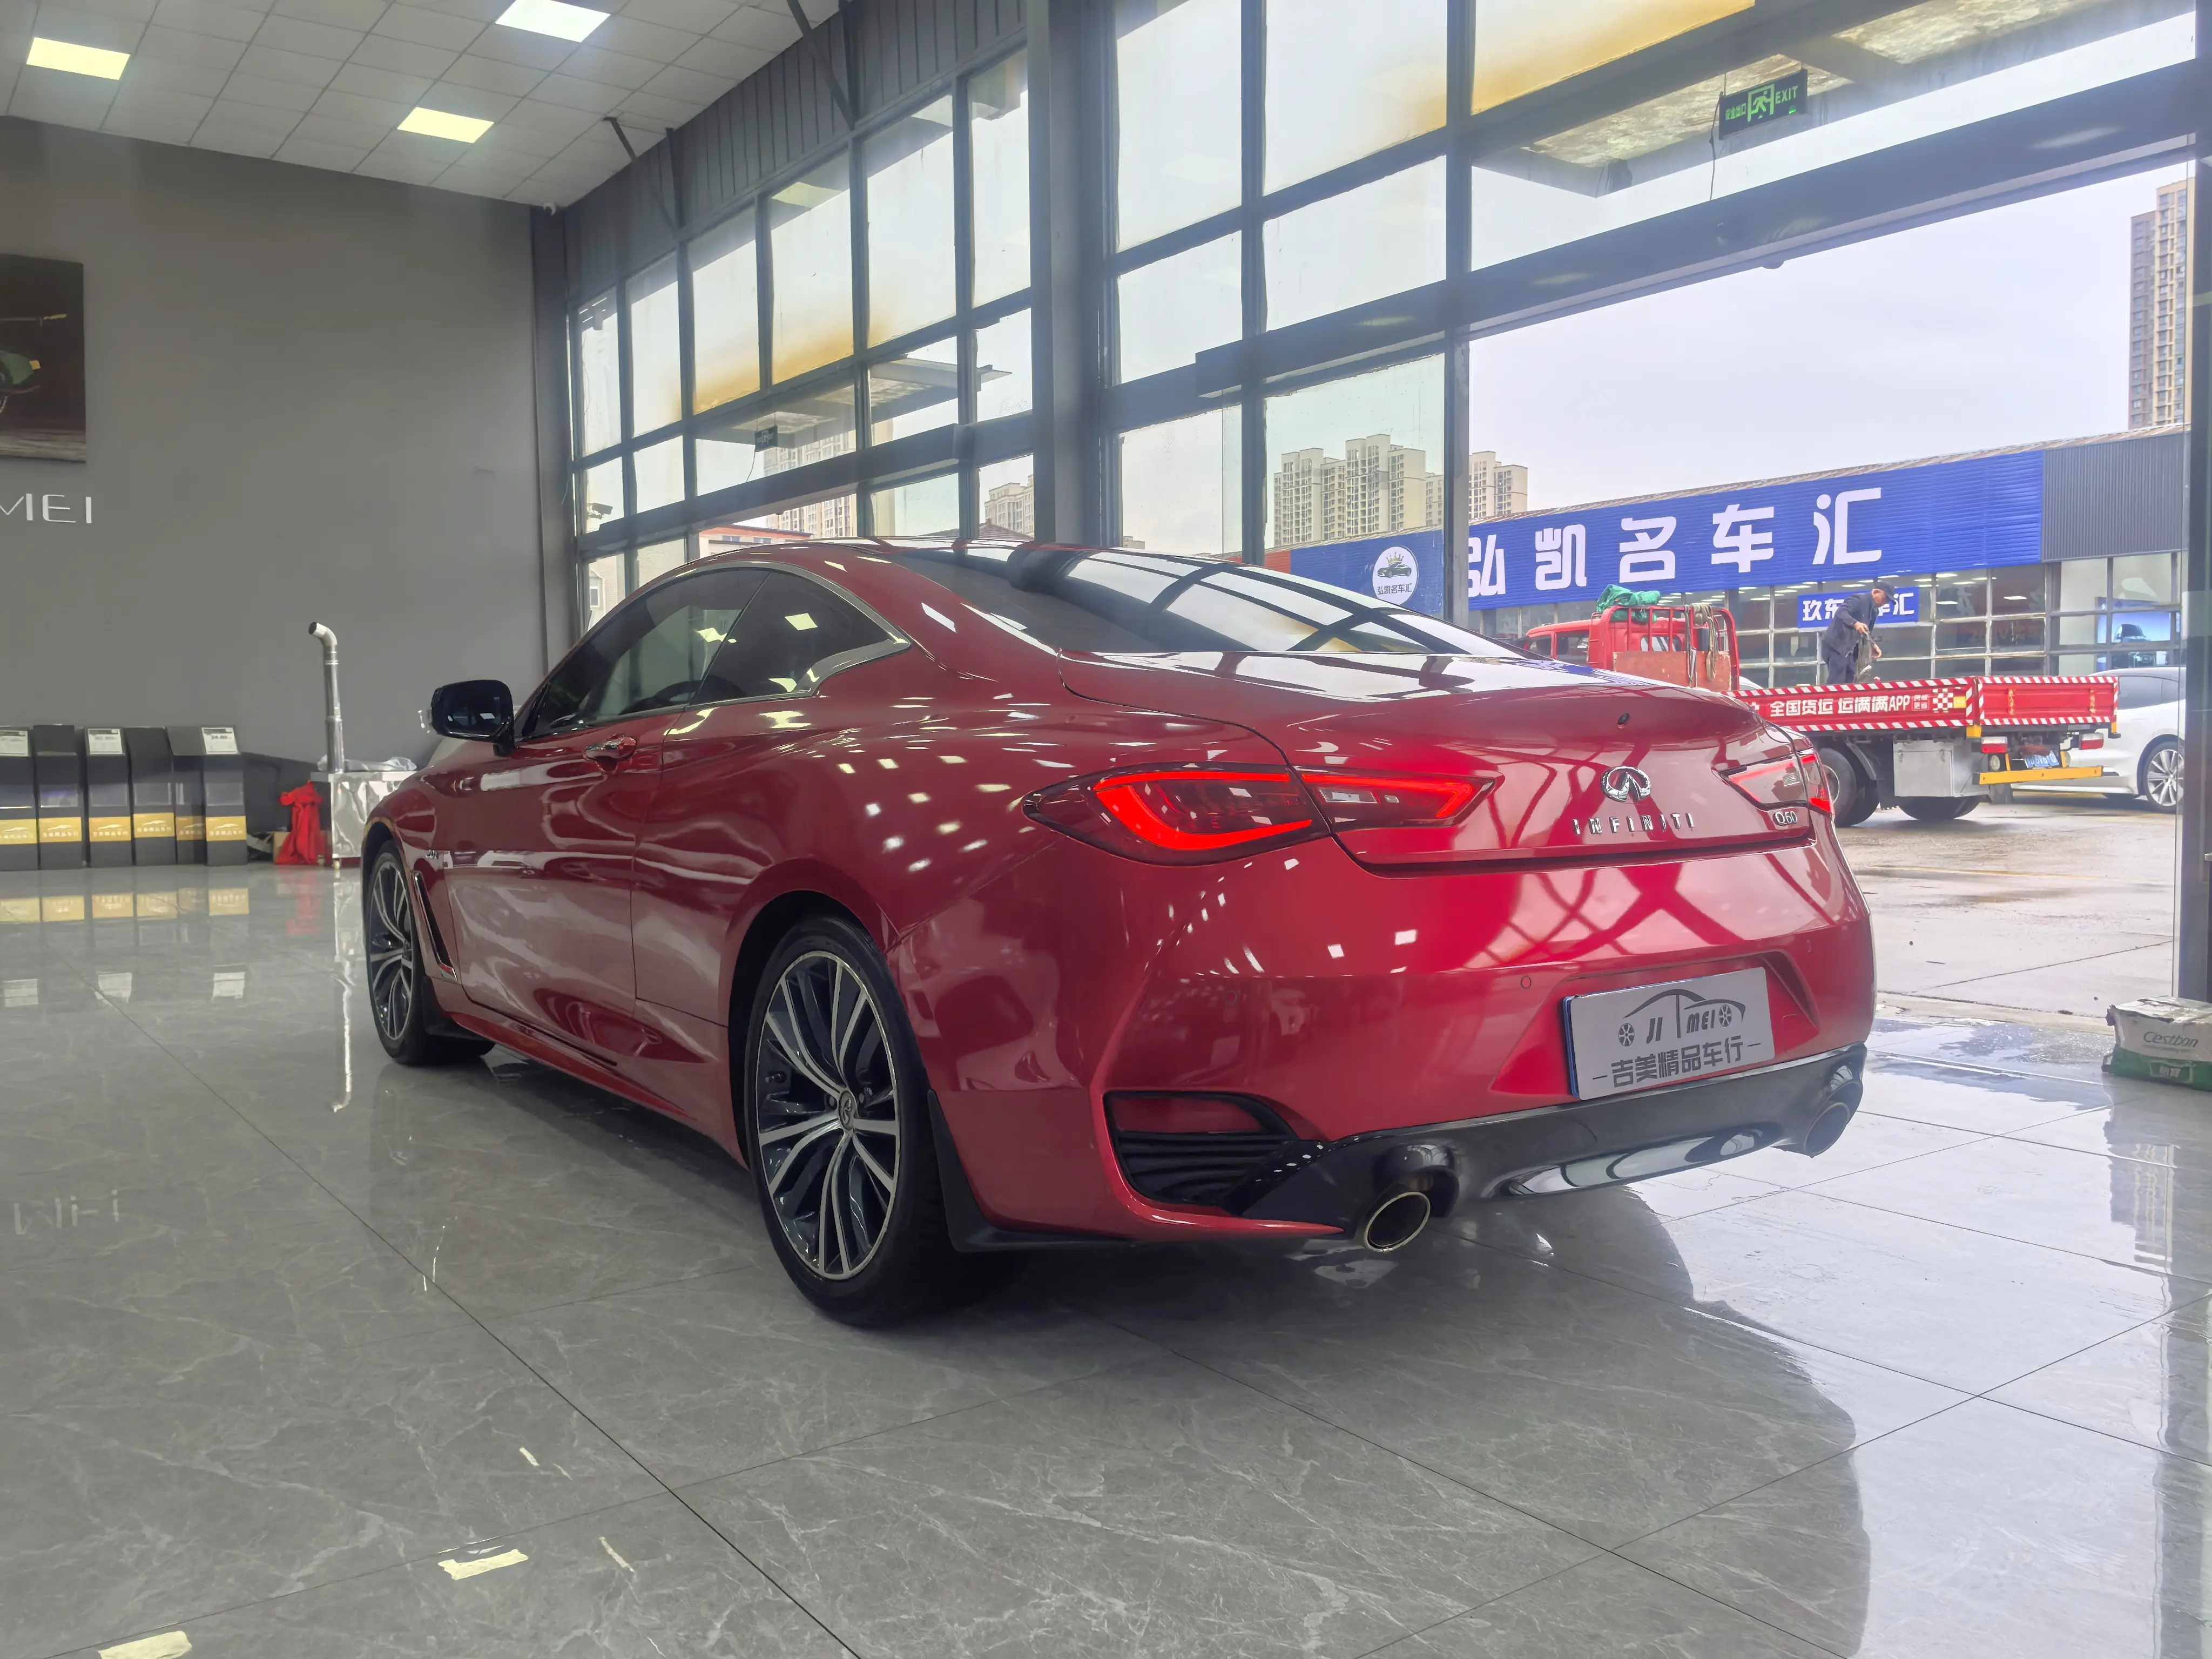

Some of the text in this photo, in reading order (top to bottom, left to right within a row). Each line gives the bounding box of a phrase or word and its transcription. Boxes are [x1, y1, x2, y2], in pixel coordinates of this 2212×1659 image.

[1775, 85, 1799, 105] EXIT
[1468, 487, 1883, 598] 弘凯名车汇
[1377, 583, 1413, 595] 弘凯名车汇
[1769, 697, 1834, 718] 全国货运
[1573, 812, 1695, 835] INFINITI
[1773, 810, 1798, 826] Q60
[1646, 1009, 1716, 1044] JI MEI
[1610, 1035, 1744, 1088] 吉美精品车行
